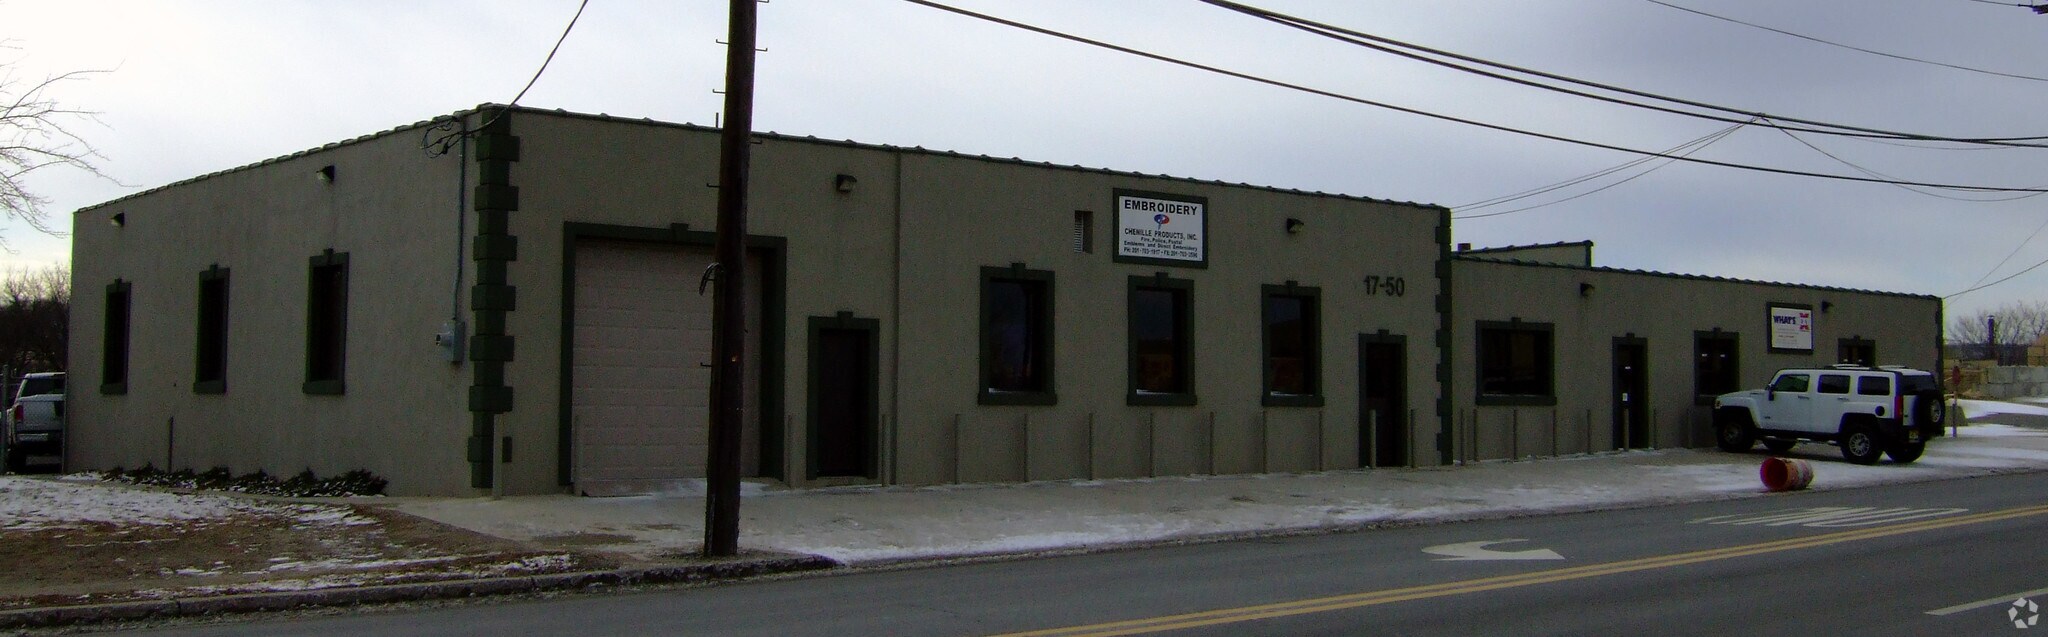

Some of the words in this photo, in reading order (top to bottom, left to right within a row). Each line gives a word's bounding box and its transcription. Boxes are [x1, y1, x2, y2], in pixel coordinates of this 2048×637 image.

[1124, 199, 1197, 215] EMBROIDERY
[1124, 228, 1152, 236] CHENILLE
[1154, 230, 1185, 240] PRODUCTS,
[1363, 275, 1405, 297] 17-50
